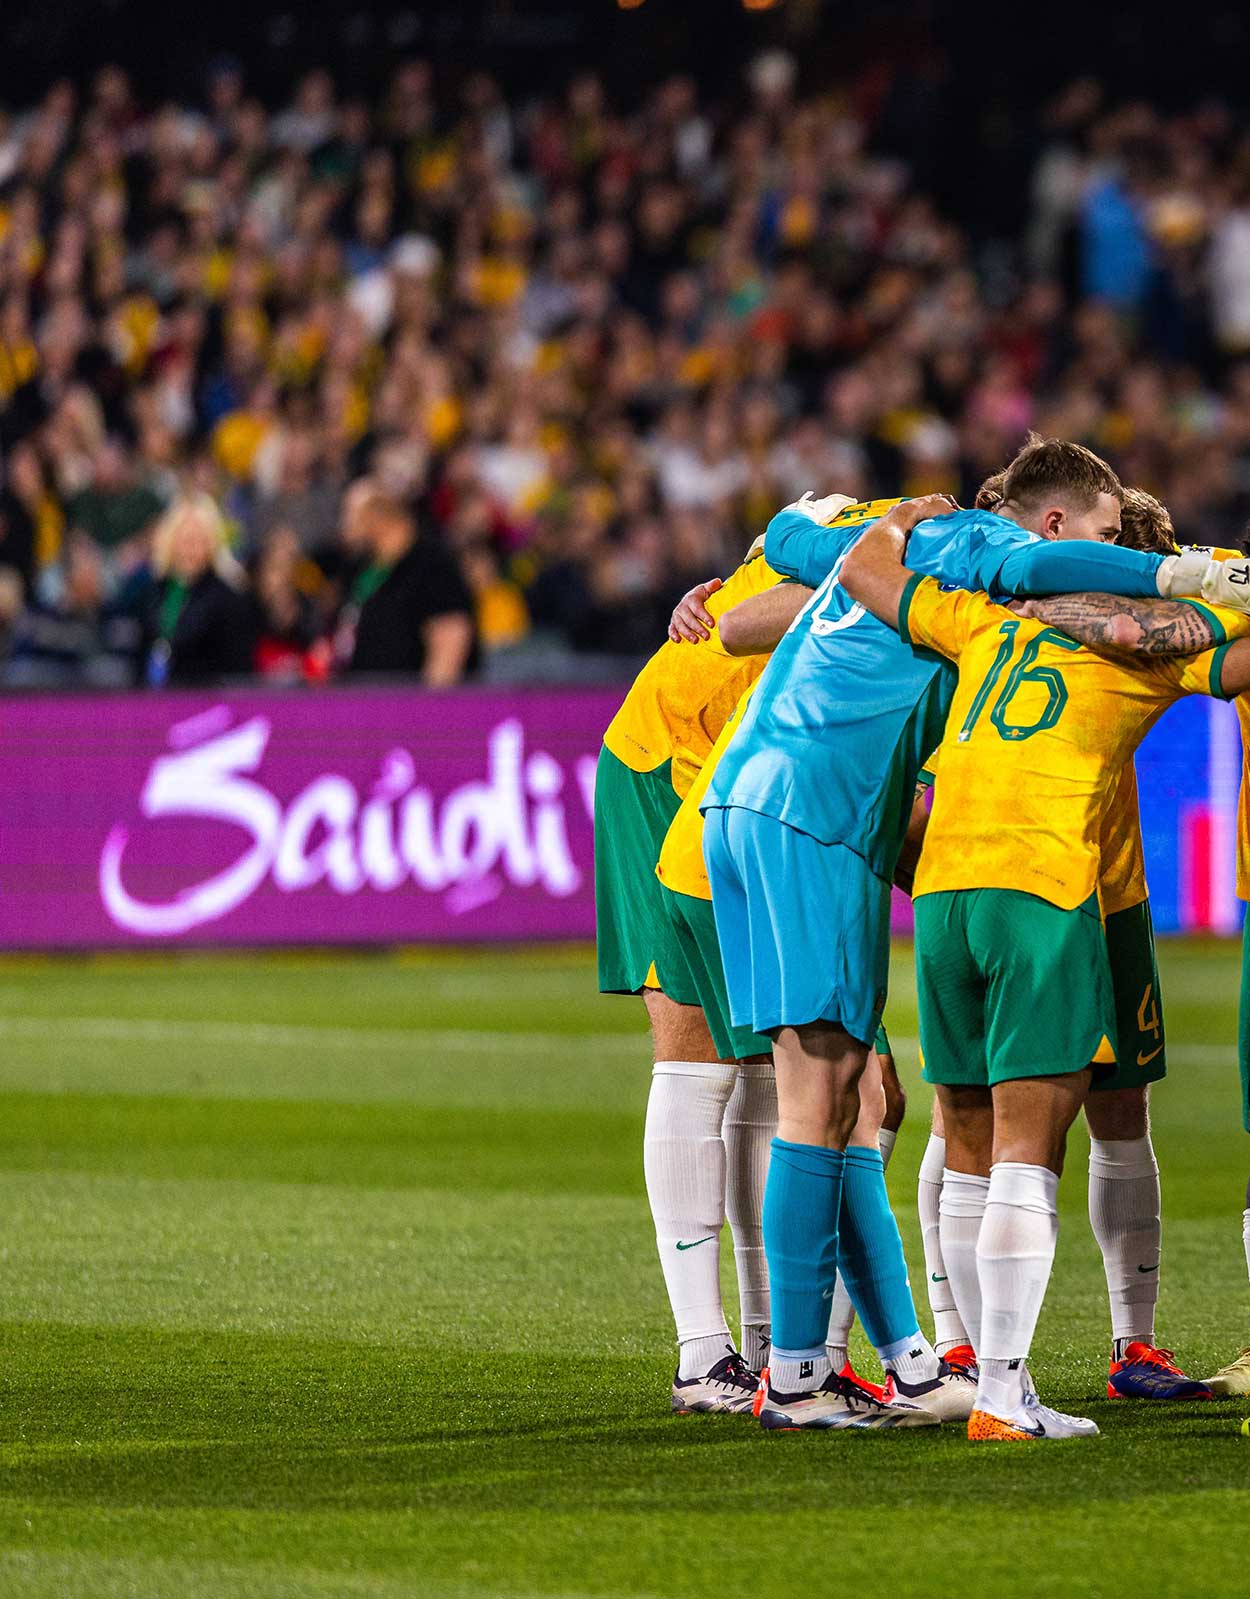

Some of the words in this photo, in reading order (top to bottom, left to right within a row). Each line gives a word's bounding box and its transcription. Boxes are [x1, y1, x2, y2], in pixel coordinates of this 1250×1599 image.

[957, 619, 1083, 742] 16
[100, 706, 582, 937] Saudi
[1136, 981, 1160, 1040] 4
